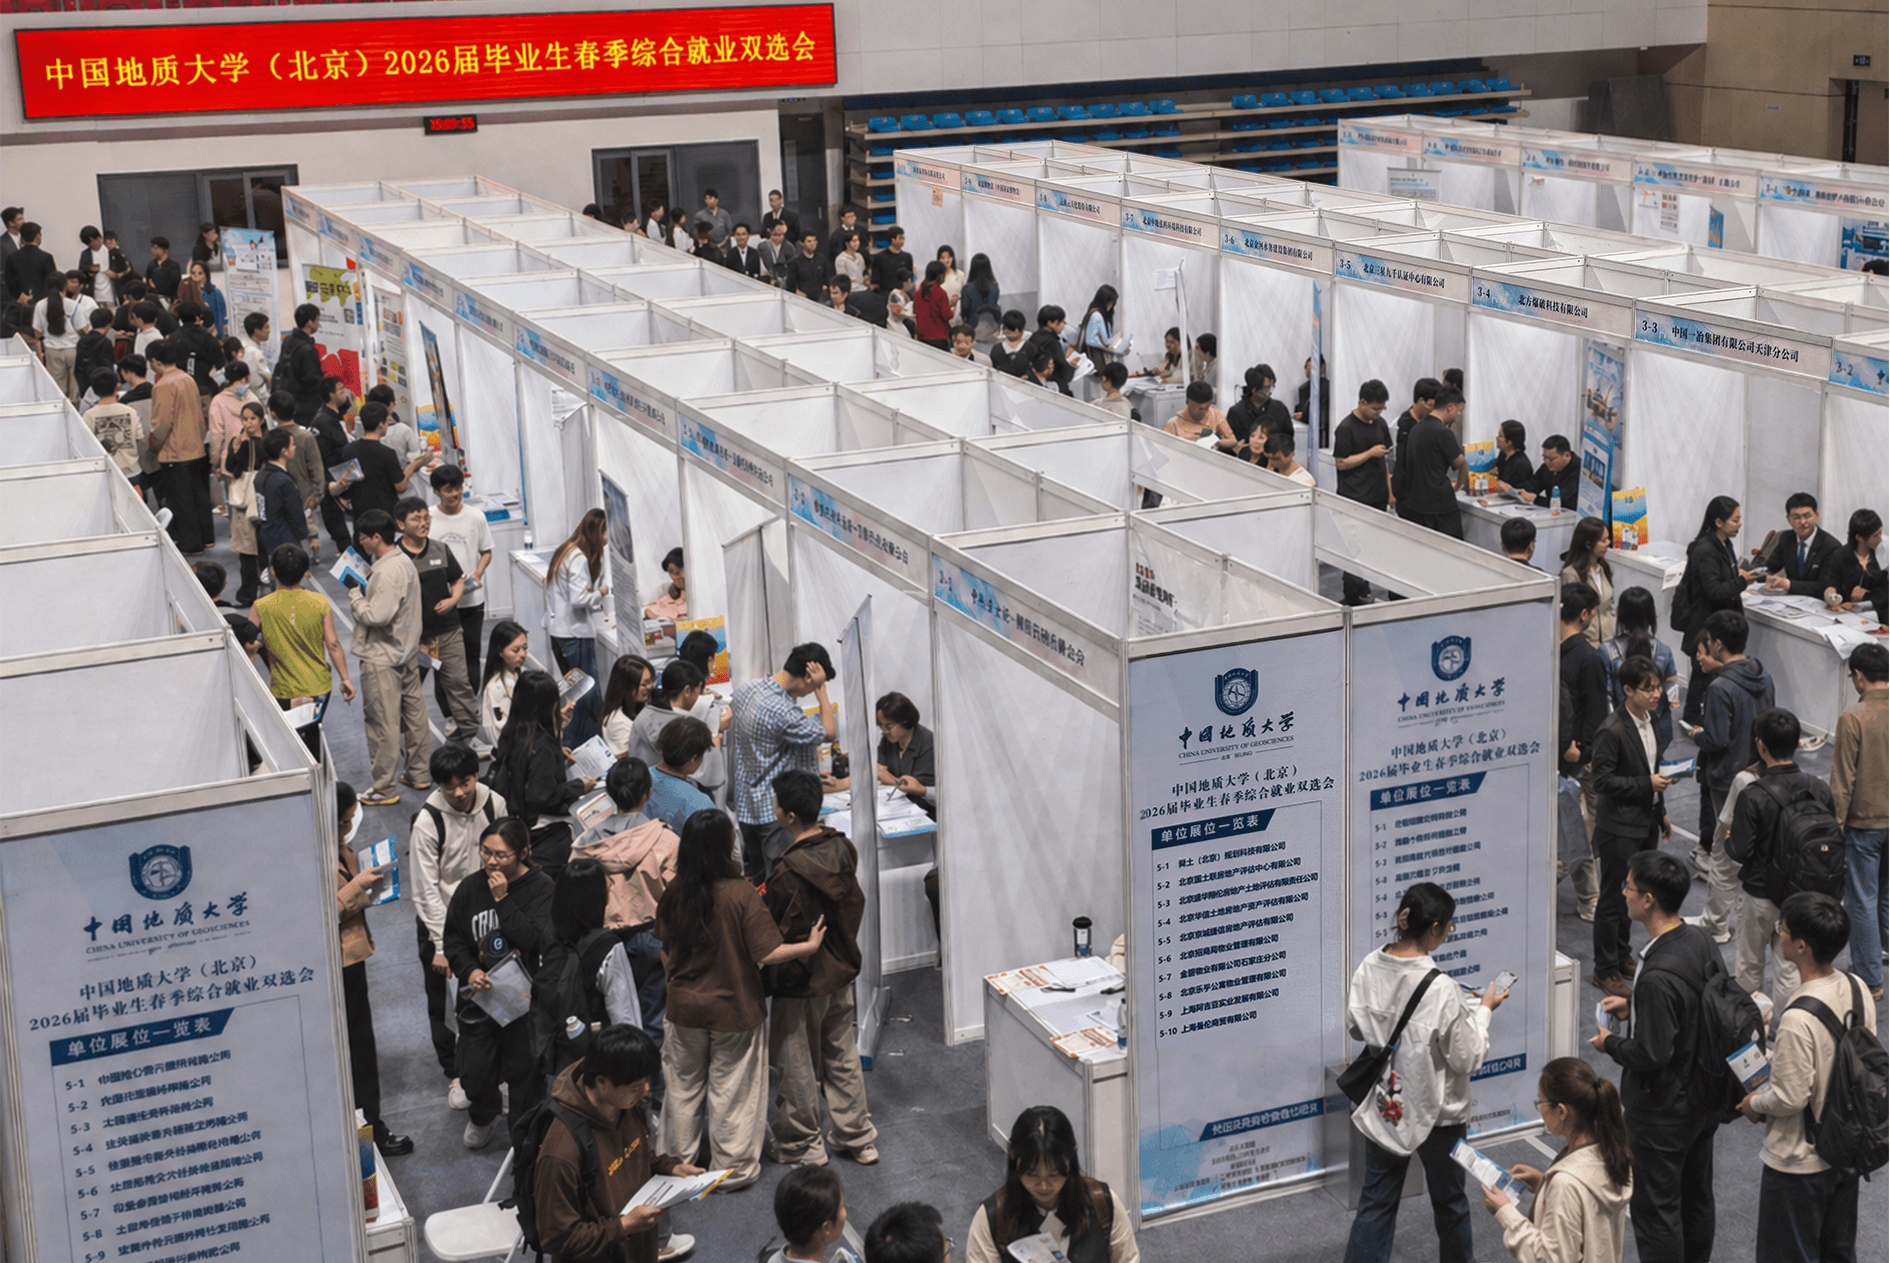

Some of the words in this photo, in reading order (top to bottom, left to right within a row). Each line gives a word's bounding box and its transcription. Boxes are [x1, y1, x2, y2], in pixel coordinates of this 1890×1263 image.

[45, 31, 815, 90] 中国地质大学（北京）2026届毕业生春季综合就业双选会
[1225, 235, 1235, 245] 3-6
[1340, 259, 1351, 270] 3-5
[1478, 287, 1491, 299] 3-4
[1642, 320, 1658, 333] 3-3
[1671, 326, 1799, 363] 中国一冶集团有限公司天津分公司
[1179, 711, 1294, 750] 中国地质大学
[1179, 749, 1200, 759] CHINA
[1201, 743, 1240, 756] UNIVERSITY
[1172, 764, 1298, 797] 中国地质大学（北京）
[1139, 776, 1335, 821] 2026届毕业生春季综合就业双选会
[1161, 814, 1259, 843] 单位展位一览表
[1157, 863, 1169, 871] 5-1
[1157, 881, 1170, 890] 5-2
[1157, 899, 1171, 909] 5-3
[1157, 918, 1171, 927] 5-4
[1158, 936, 1171, 946] 5-5
[1158, 955, 1172, 964] 5-6
[80, 954, 258, 1001] 中国地质大学（北京）
[1159, 973, 1172, 982] 5-7
[1159, 992, 1172, 1001] 5-8
[1159, 1010, 1173, 1019] 5-9
[67, 1016, 213, 1058] 单位展位一览表
[1160, 1027, 1178, 1038] 5-10
[65, 1079, 85, 1091] 5-1
[68, 1100, 88, 1113] 5-2
[70, 1122, 91, 1134] 5-3
[73, 1143, 93, 1156] 5-4
[76, 1165, 96, 1178] 5-5
[78, 1186, 98, 1199] 5-6
[81, 1208, 100, 1220] 5-7
[83, 1229, 103, 1242] 5-8
